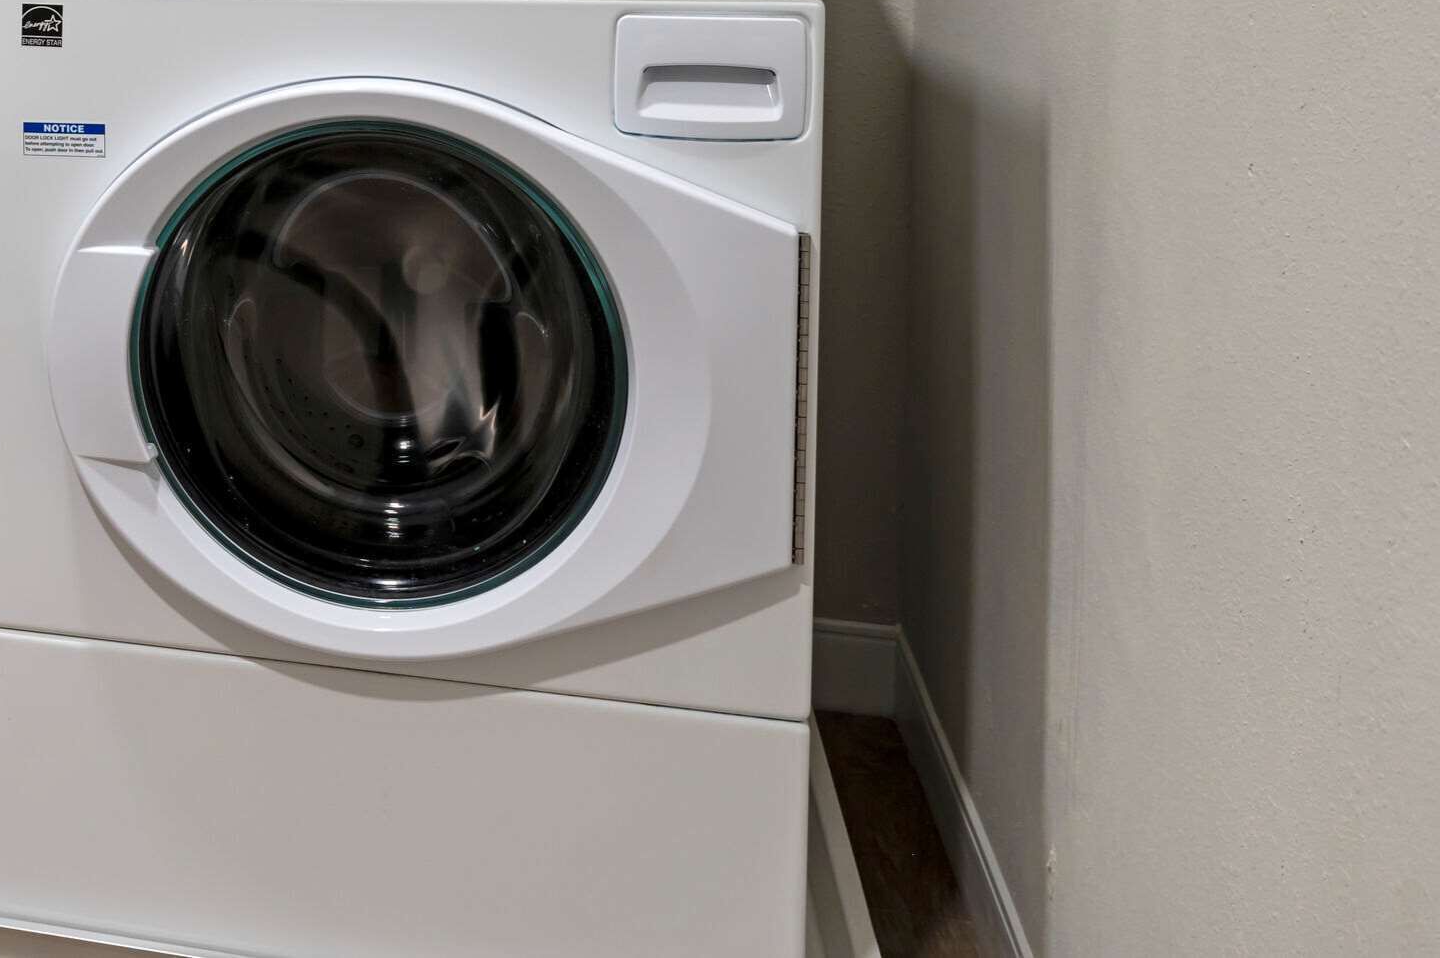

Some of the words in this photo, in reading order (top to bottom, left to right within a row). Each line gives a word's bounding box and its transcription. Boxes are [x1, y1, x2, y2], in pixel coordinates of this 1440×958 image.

[22, 37, 46, 46] ENERGY
[47, 38, 62, 47] STAR
[43, 124, 85, 133] NOTICE
